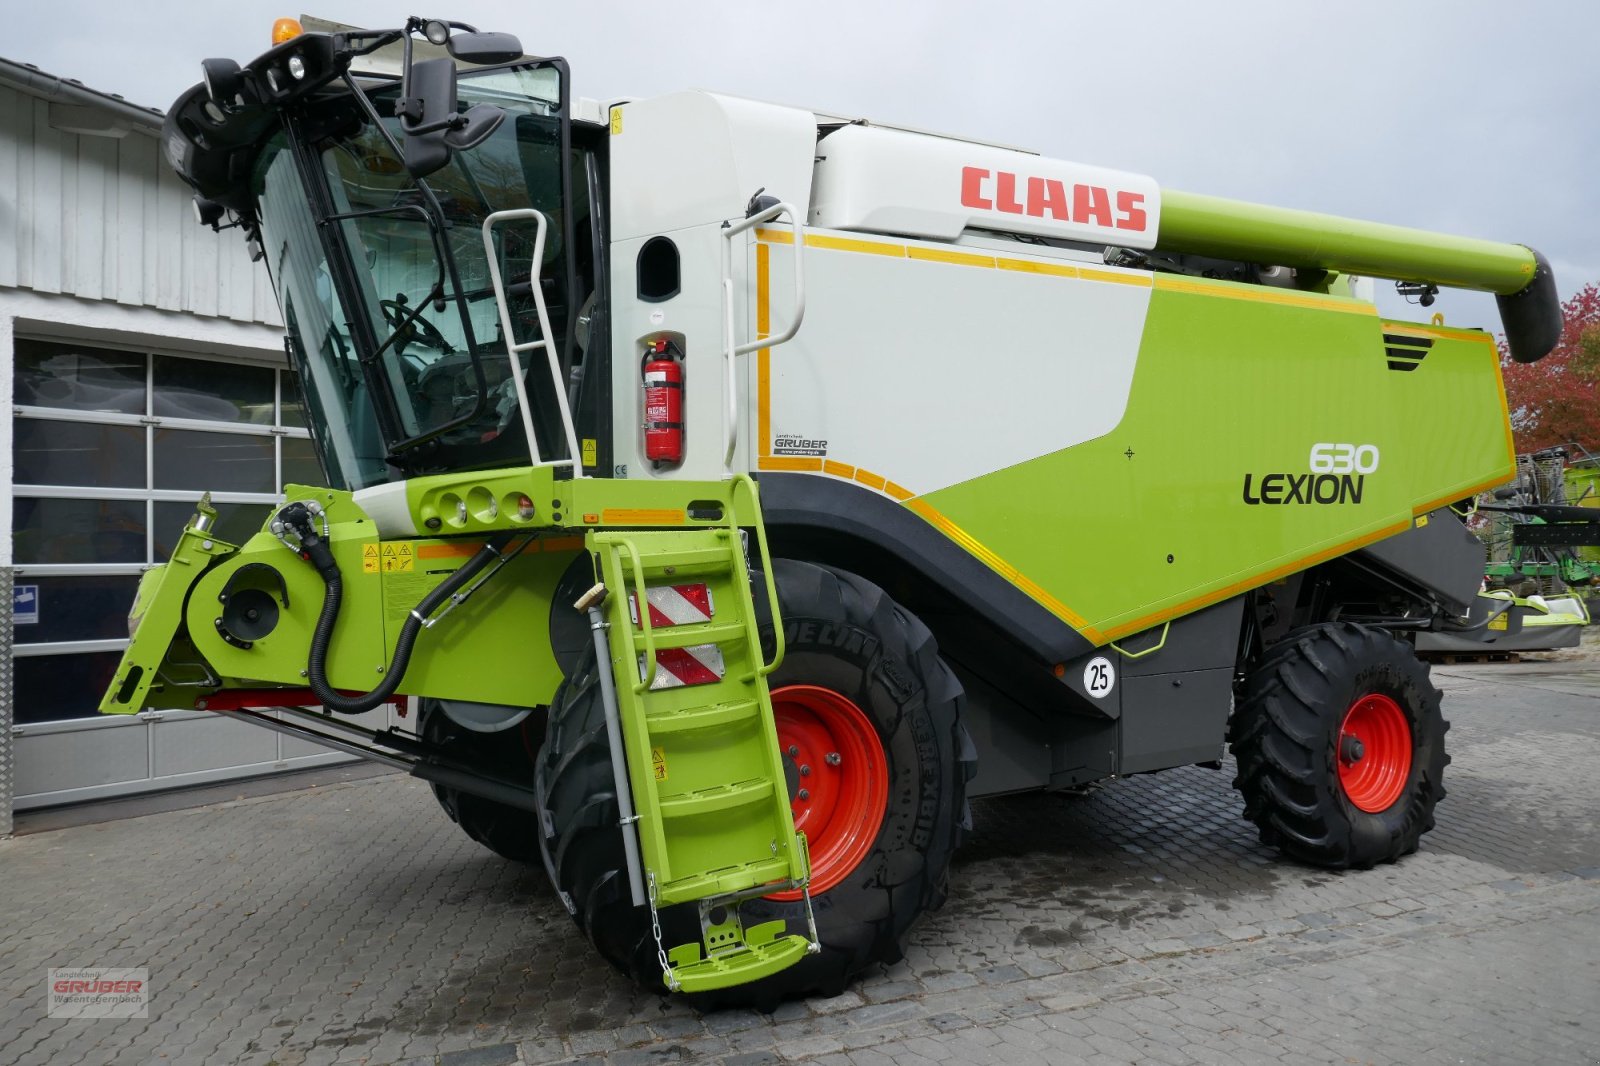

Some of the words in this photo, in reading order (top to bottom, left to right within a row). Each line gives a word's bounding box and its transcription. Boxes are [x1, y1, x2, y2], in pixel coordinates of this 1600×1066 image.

[961, 166, 1147, 232] CLAAS
[774, 438, 828, 449] GRUBER
[1309, 443, 1380, 474] 630
[1243, 473, 1364, 505] LEXION
[1090, 664, 1108, 691] 25
